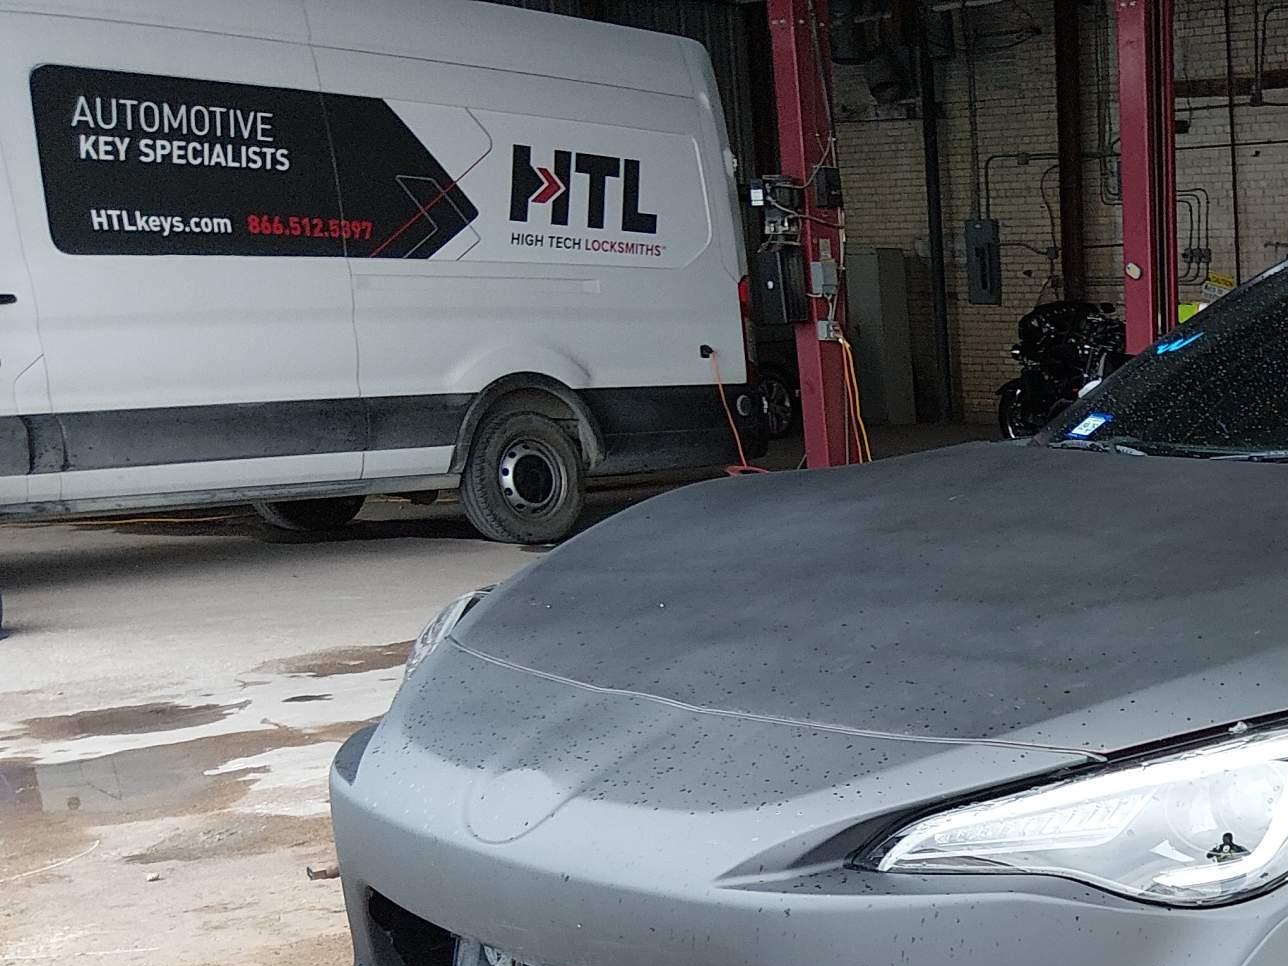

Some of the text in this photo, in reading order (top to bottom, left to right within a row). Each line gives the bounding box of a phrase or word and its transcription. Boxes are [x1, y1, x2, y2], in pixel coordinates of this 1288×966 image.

[71, 95, 273, 141] AUTOMOTIVE
[79, 135, 290, 171] KEY SPECIALISTS
[509, 144, 657, 234] HTL
[90, 209, 233, 236] HTLkeys.com
[511, 233, 544, 248] HIGH
[549, 235, 582, 250] TECH
